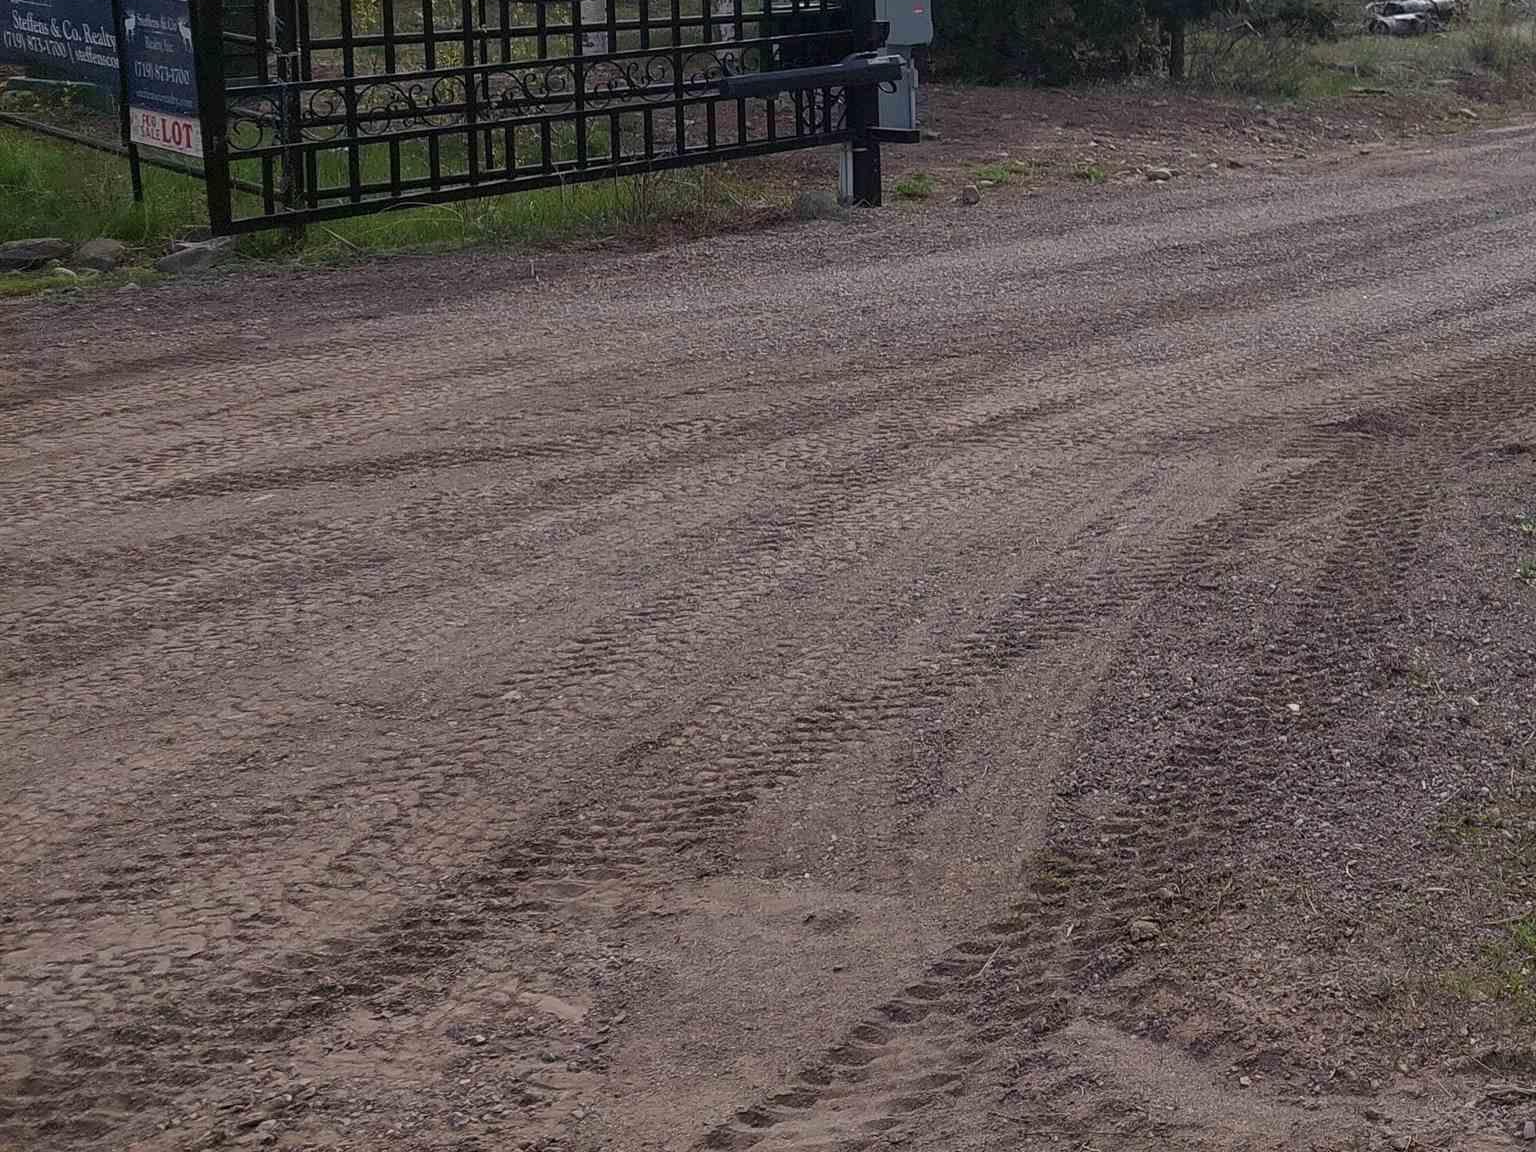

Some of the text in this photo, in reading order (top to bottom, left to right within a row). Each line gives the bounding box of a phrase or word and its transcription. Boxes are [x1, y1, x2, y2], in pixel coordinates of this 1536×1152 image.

[12, 9, 117, 52] Steffens & Co. Realty
[160, 118, 193, 149] LOT
